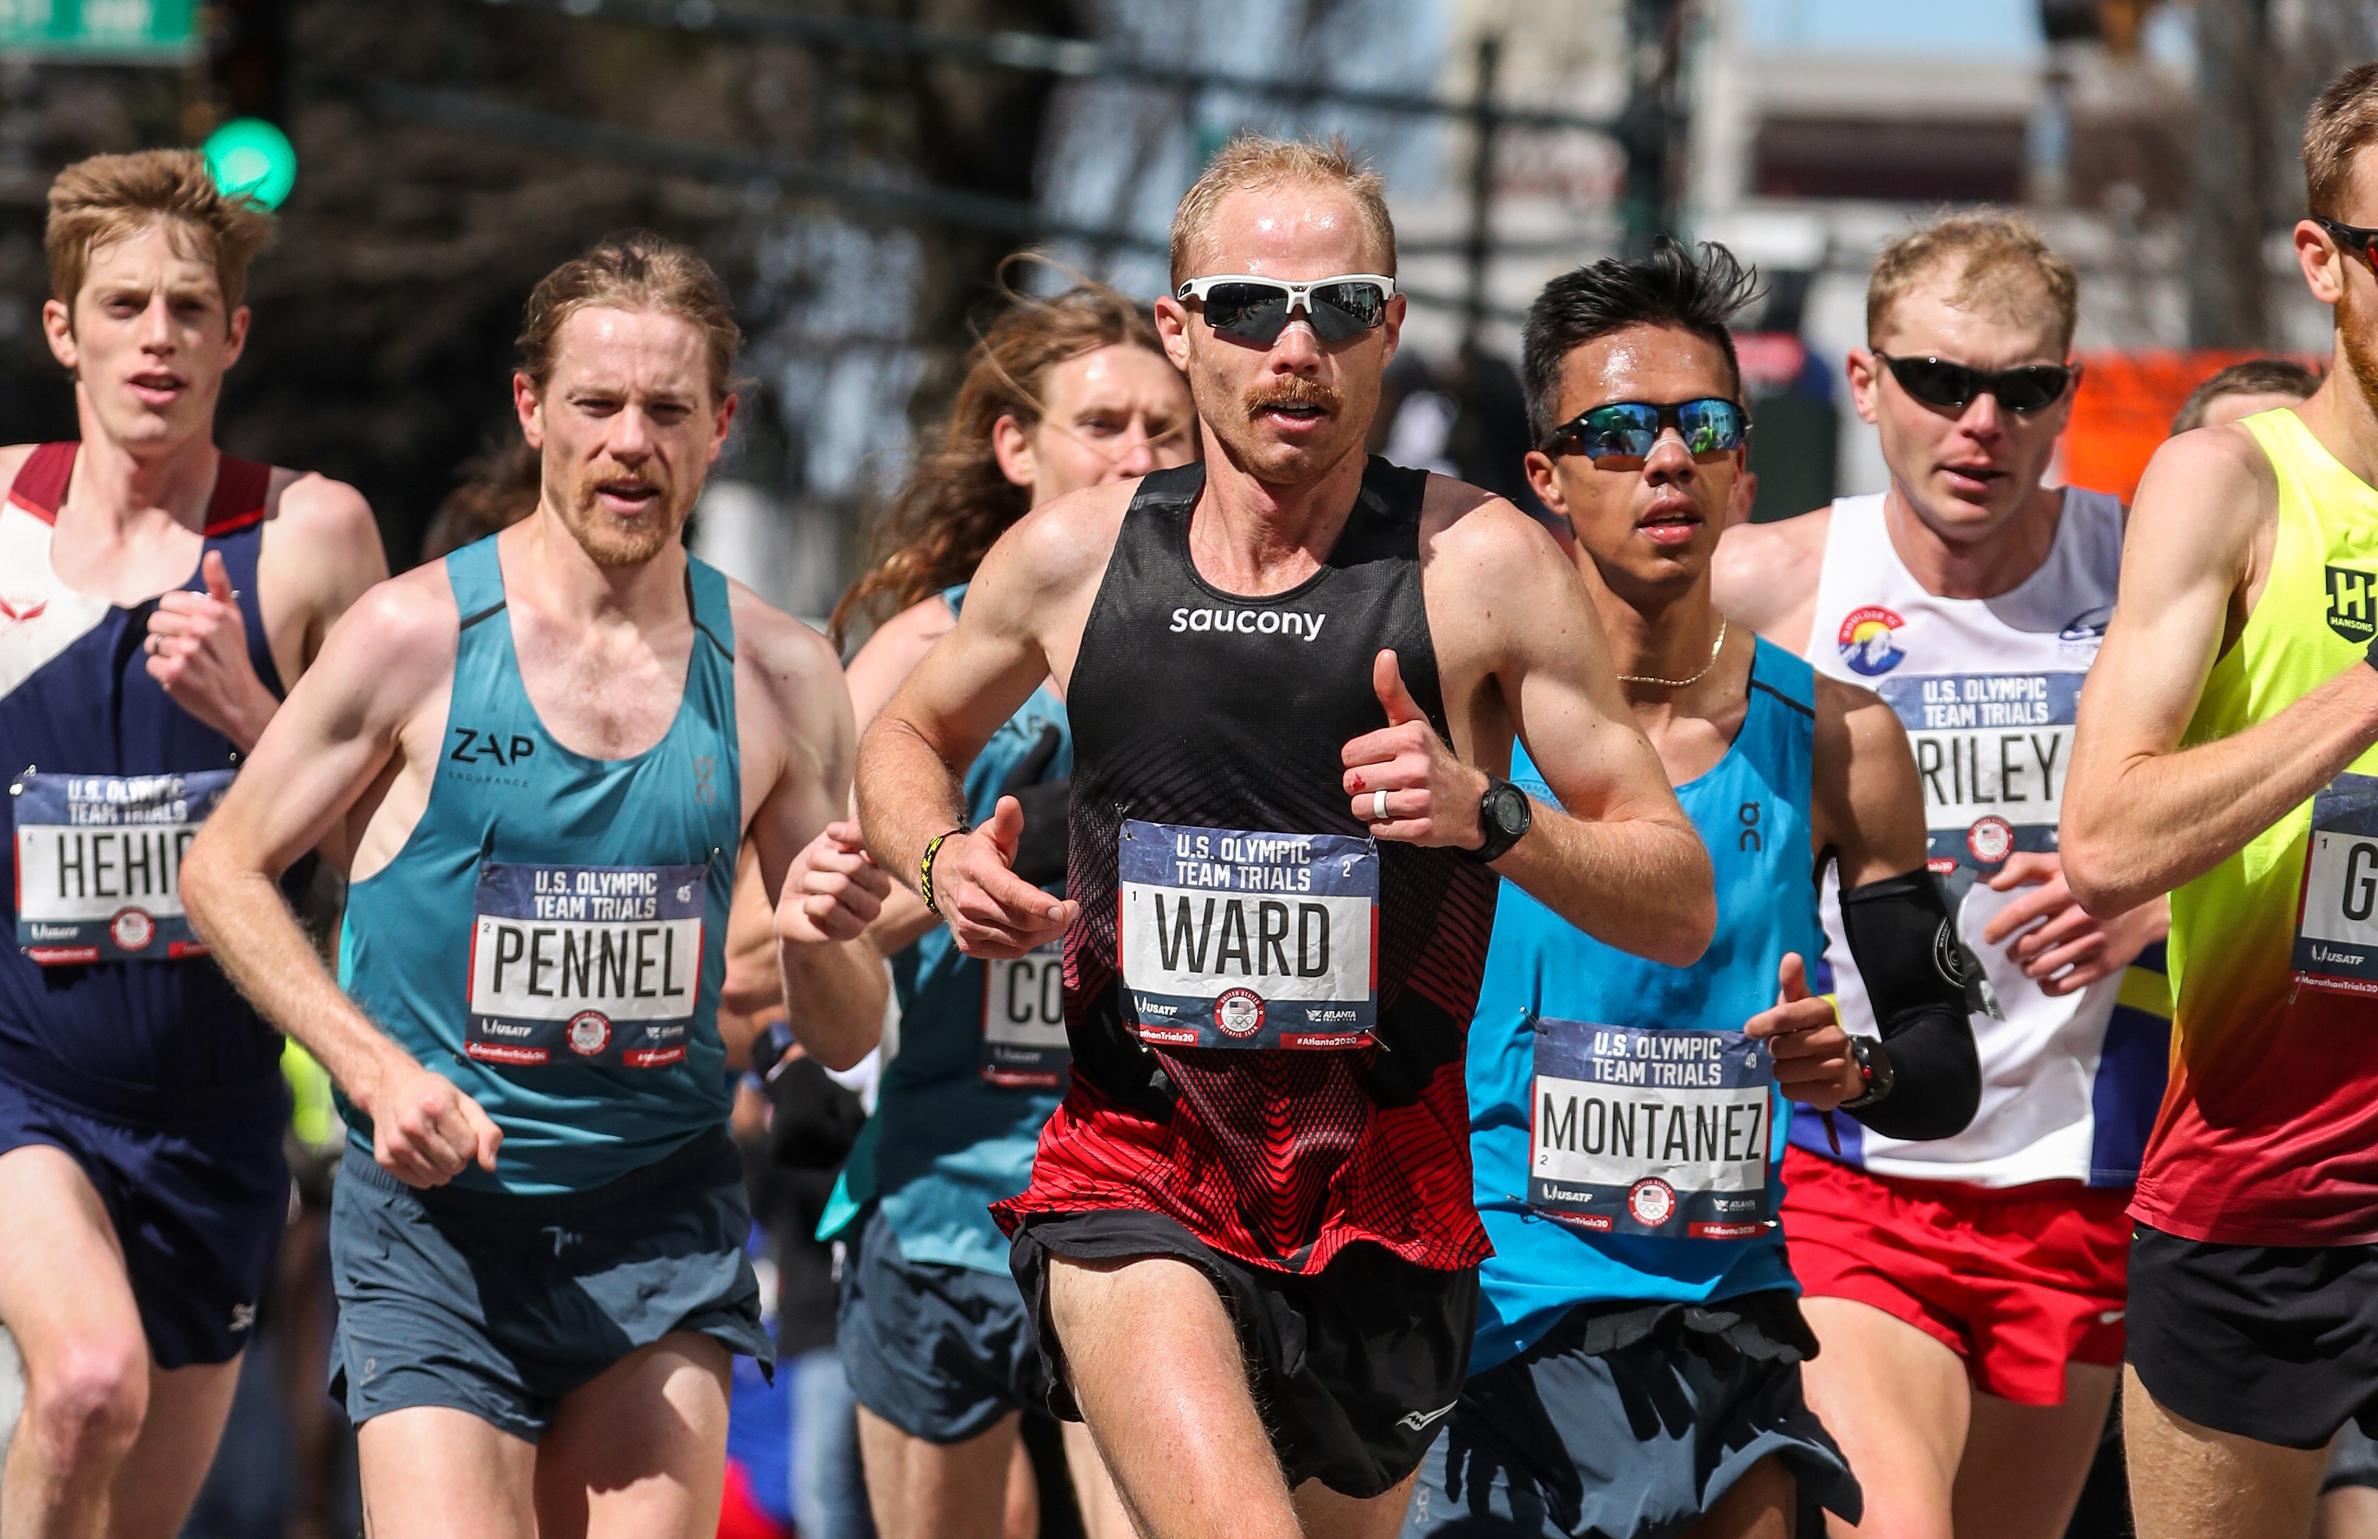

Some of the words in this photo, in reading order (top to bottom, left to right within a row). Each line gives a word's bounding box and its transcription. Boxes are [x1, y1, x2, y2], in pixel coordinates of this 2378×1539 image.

[1169, 607, 1326, 642] saucony
[2330, 616, 2374, 632] HANSONS
[1922, 680, 1961, 704] U.S.
[1964, 677, 2048, 702] OLYMPIC
[1924, 704, 1976, 728] TEAM
[1982, 702, 2049, 726] TRIALS
[451, 727, 534, 767] ZAP
[448, 771, 529, 788] ENDURANCE
[1917, 732, 2062, 806] RILEY
[68, 779, 104, 801] U.S.
[107, 777, 186, 803] OLYMPC
[69, 802, 118, 824] TEAM
[1177, 834, 1215, 860] U.S.
[1220, 838, 1311, 865] OLYMPIC
[2321, 838, 2328, 850] 1
[1176, 861, 1230, 888] TEAM
[1238, 866, 1311, 892] TRIALS
[1342, 861, 1351, 878] 2
[2342, 842, 2378, 921] G
[535, 871, 570, 893] U.S.
[576, 871, 658, 896] OLYMPIC
[534, 896, 586, 919] TEAM
[592, 897, 657, 920] TRIALS
[1132, 891, 1138, 902] 1
[483, 922, 492, 933] 2
[1155, 893, 1330, 978] WARD
[493, 925, 685, 998] PENNEL
[2326, 952, 2365, 966] USATF
[1146, 1003, 1178, 1016] USATF
[1322, 1011, 1357, 1019] ATLANTA
[1125, 1026, 1195, 1042] athonTrials20
[1296, 1037, 1357, 1047] #Atlanta2020
[1594, 1032, 1631, 1058] U.S.
[1636, 1036, 1722, 1061] OLYMPIC
[1592, 1057, 1646, 1084] TEAM
[1652, 1061, 1722, 1086] TRIALS
[1543, 1092, 1763, 1162] MONTANEZ
[1540, 1154, 1548, 1166] 2
[1557, 1190, 1593, 1203] USATF
